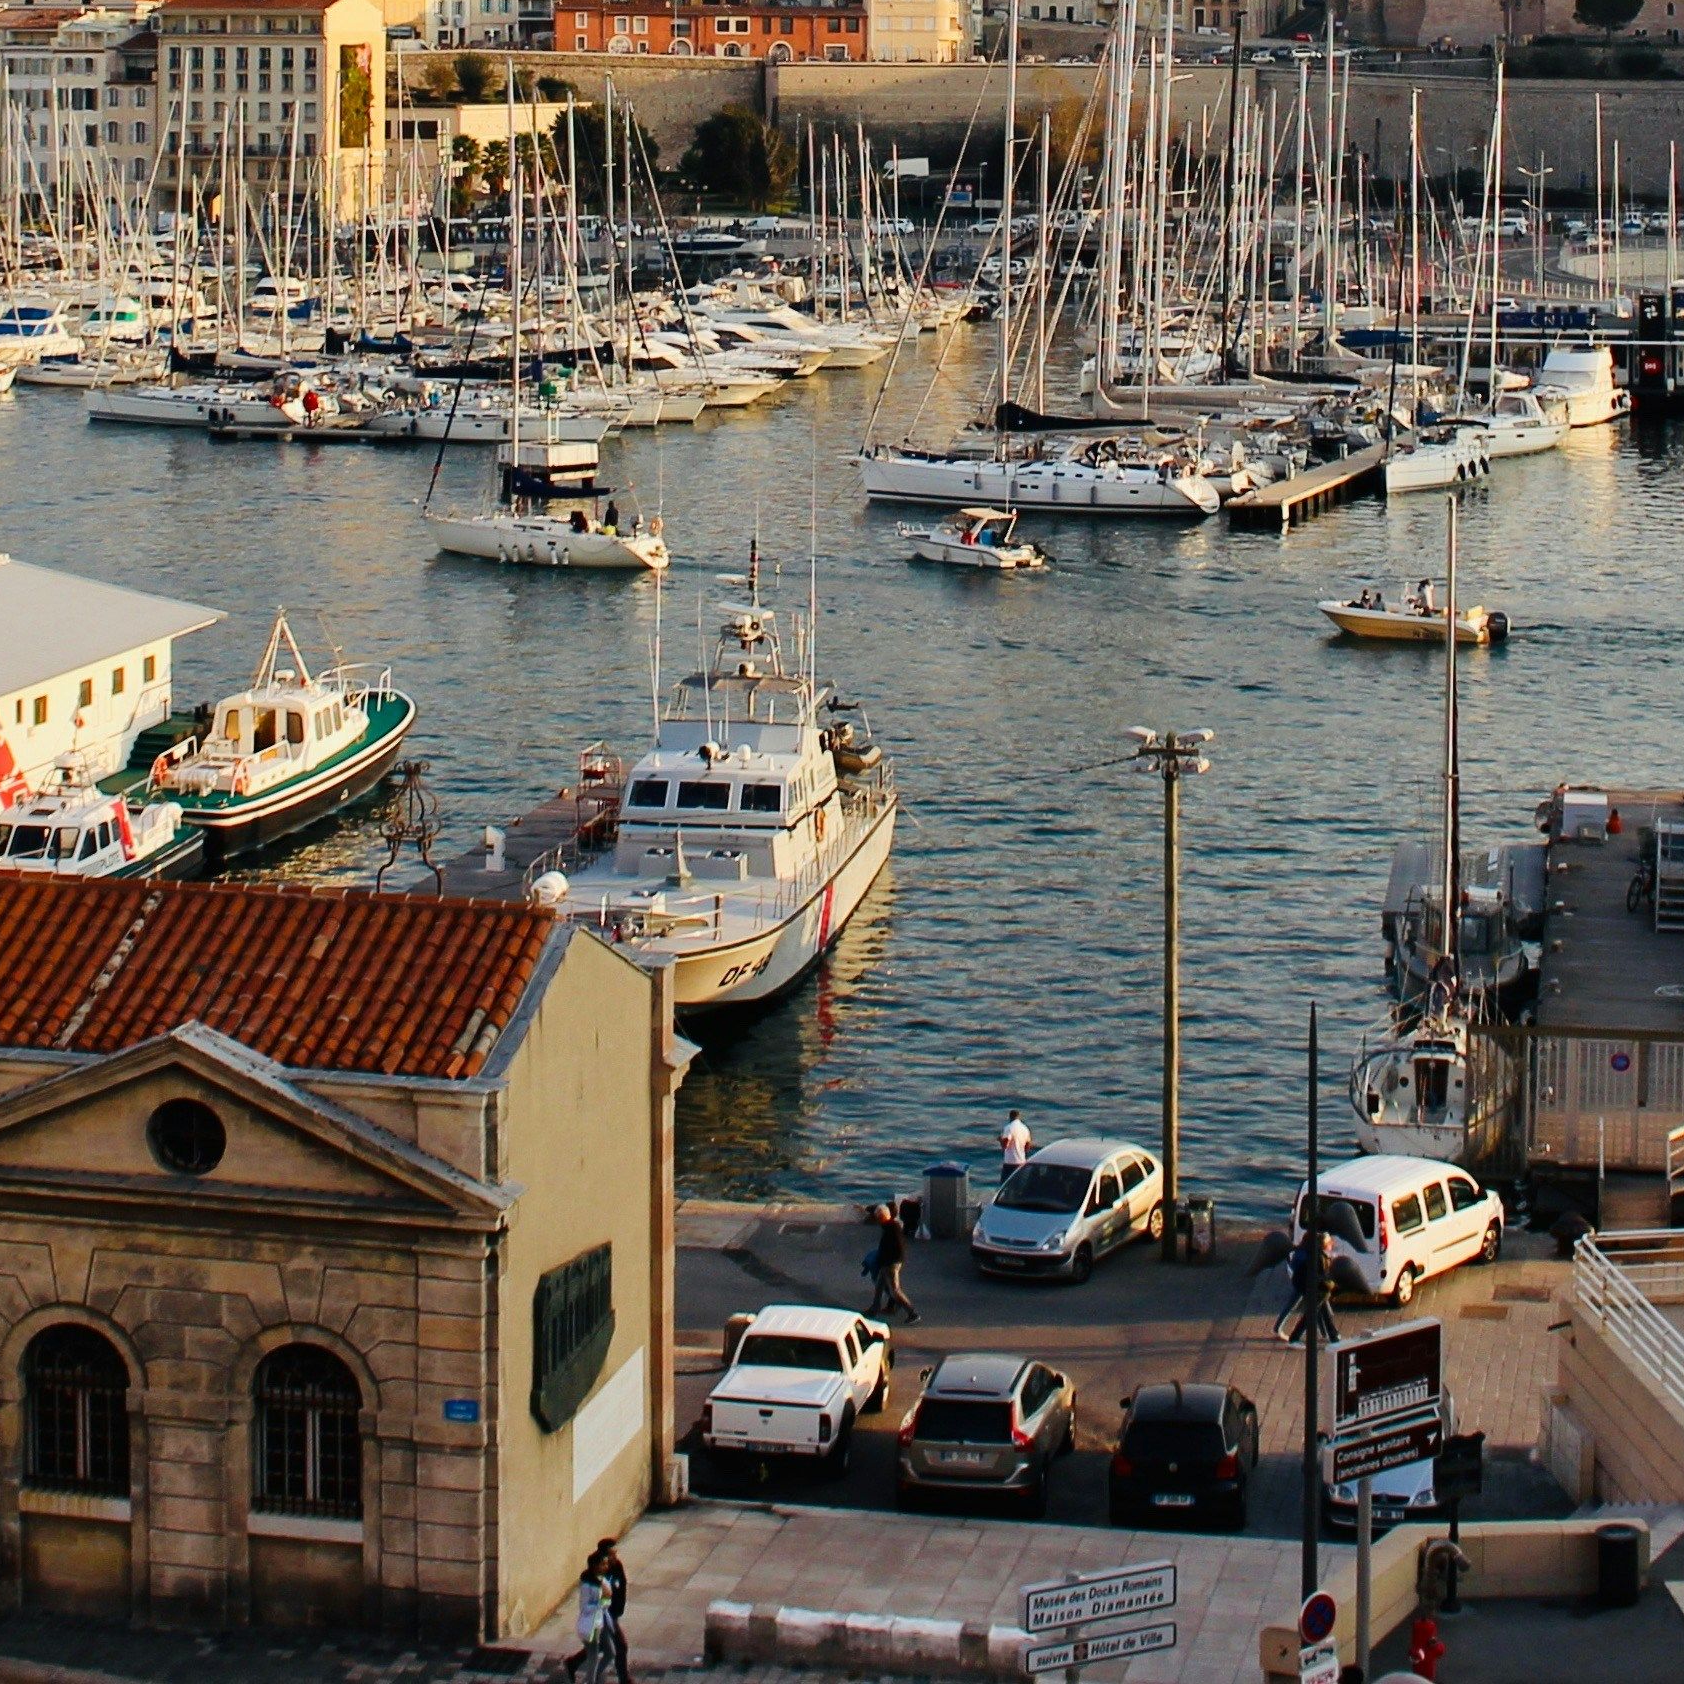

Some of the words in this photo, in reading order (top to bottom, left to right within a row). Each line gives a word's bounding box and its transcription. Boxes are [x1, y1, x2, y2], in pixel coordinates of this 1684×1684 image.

[718, 961, 752, 987] DF
[1337, 1446, 1375, 1464] Consigne
[1378, 1435, 1411, 1452] sanitaire
[1033, 1594, 1066, 1609] Musée
[1068, 1591, 1086, 1604] des
[1089, 1585, 1119, 1599] Docks
[1121, 1576, 1163, 1592] Romains
[1033, 1609, 1083, 1626] Maison
[1092, 1591, 1164, 1615] Diamantée
[1036, 1650, 1070, 1667] suivre
[1091, 1640, 1120, 1655] Hôtel
[1122, 1636, 1136, 1650] de
[1140, 1632, 1164, 1646] Ville
